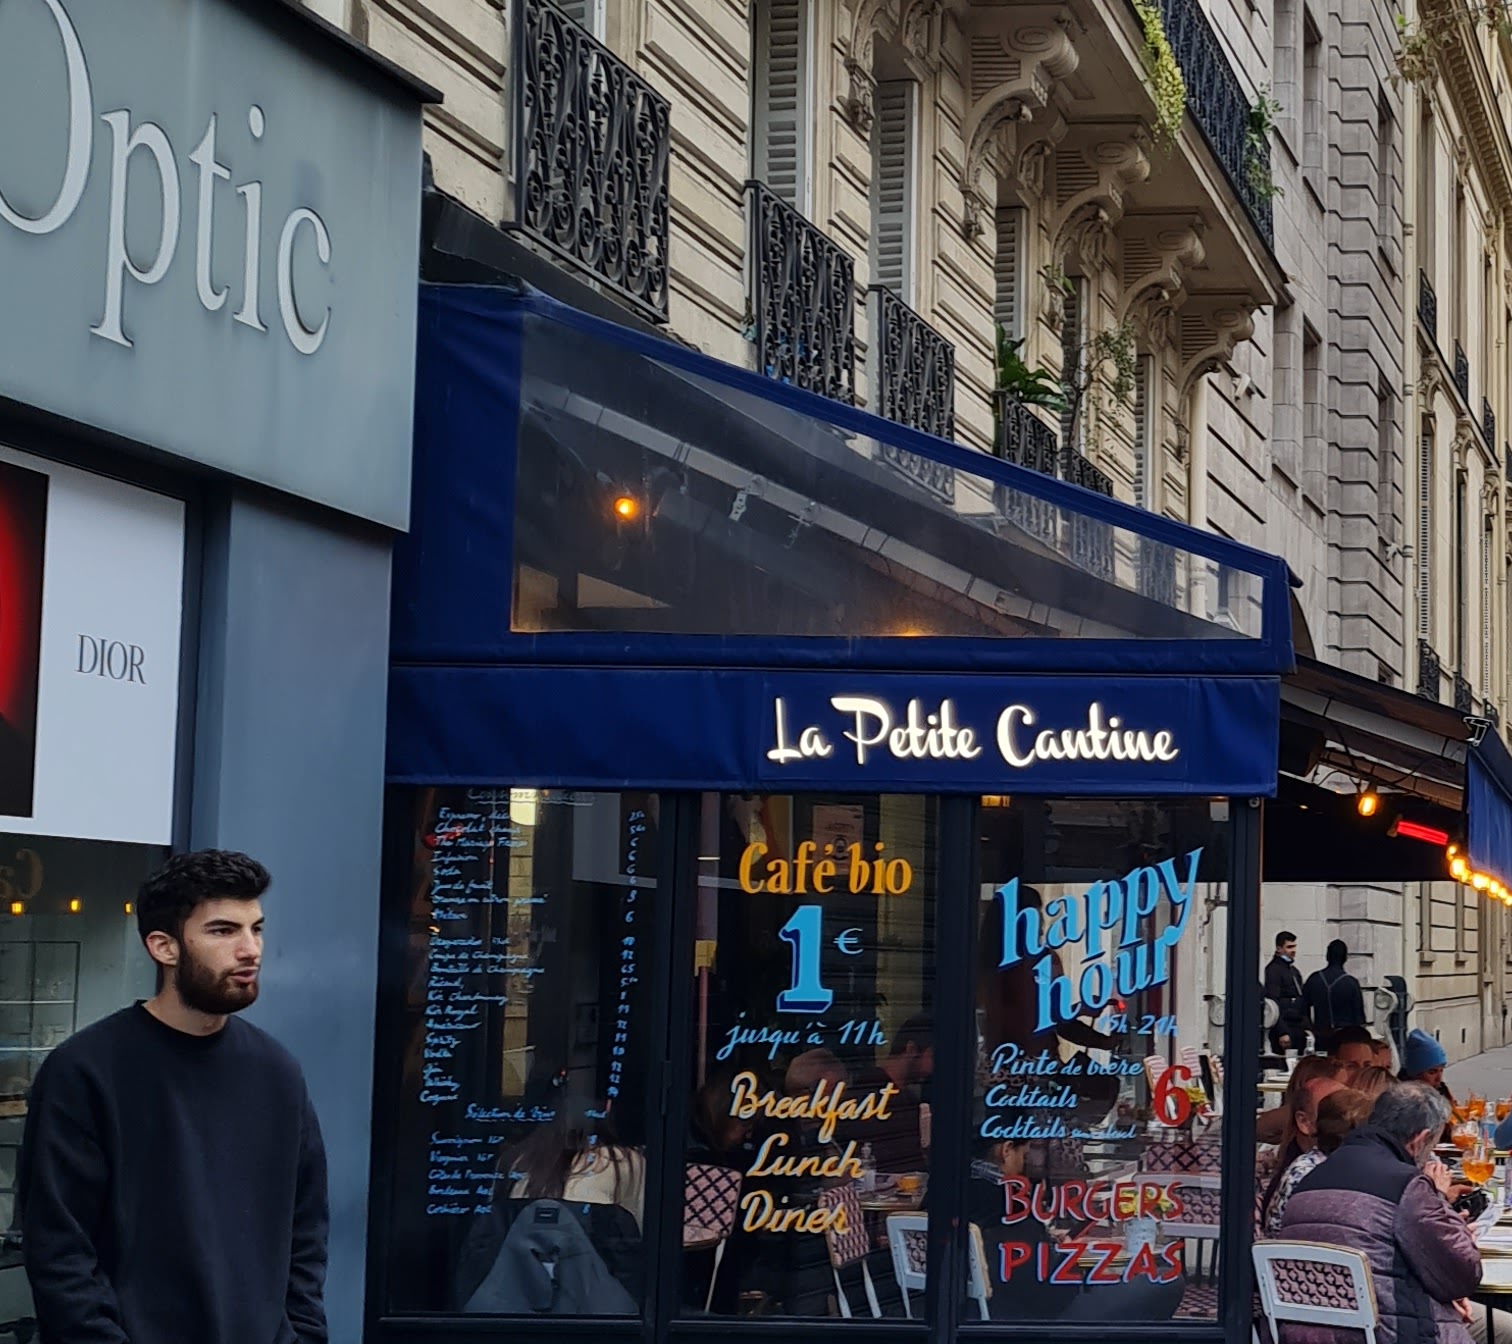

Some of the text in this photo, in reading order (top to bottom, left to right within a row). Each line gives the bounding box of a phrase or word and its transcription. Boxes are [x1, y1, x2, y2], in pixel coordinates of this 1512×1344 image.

[77, 633, 147, 685] DIOR
[767, 697, 1179, 768] La Petite Cantine
[739, 841, 913, 894] Café bio
[995, 847, 1204, 970] happy
[1032, 936, 1170, 1035] hour
[716, 1012, 888, 1060] jusqu'à 11h
[992, 1043, 1144, 1076] Pinte de bière
[729, 1071, 899, 1143] Breakfast
[984, 1065, 1191, 1127] Cocktails 6
[979, 1115, 1066, 1139] Cocktails
[746, 1133, 865, 1178] Lunch
[999, 1175, 1184, 1225] BURGERS
[998, 1240, 1185, 1285] PIZZAS
